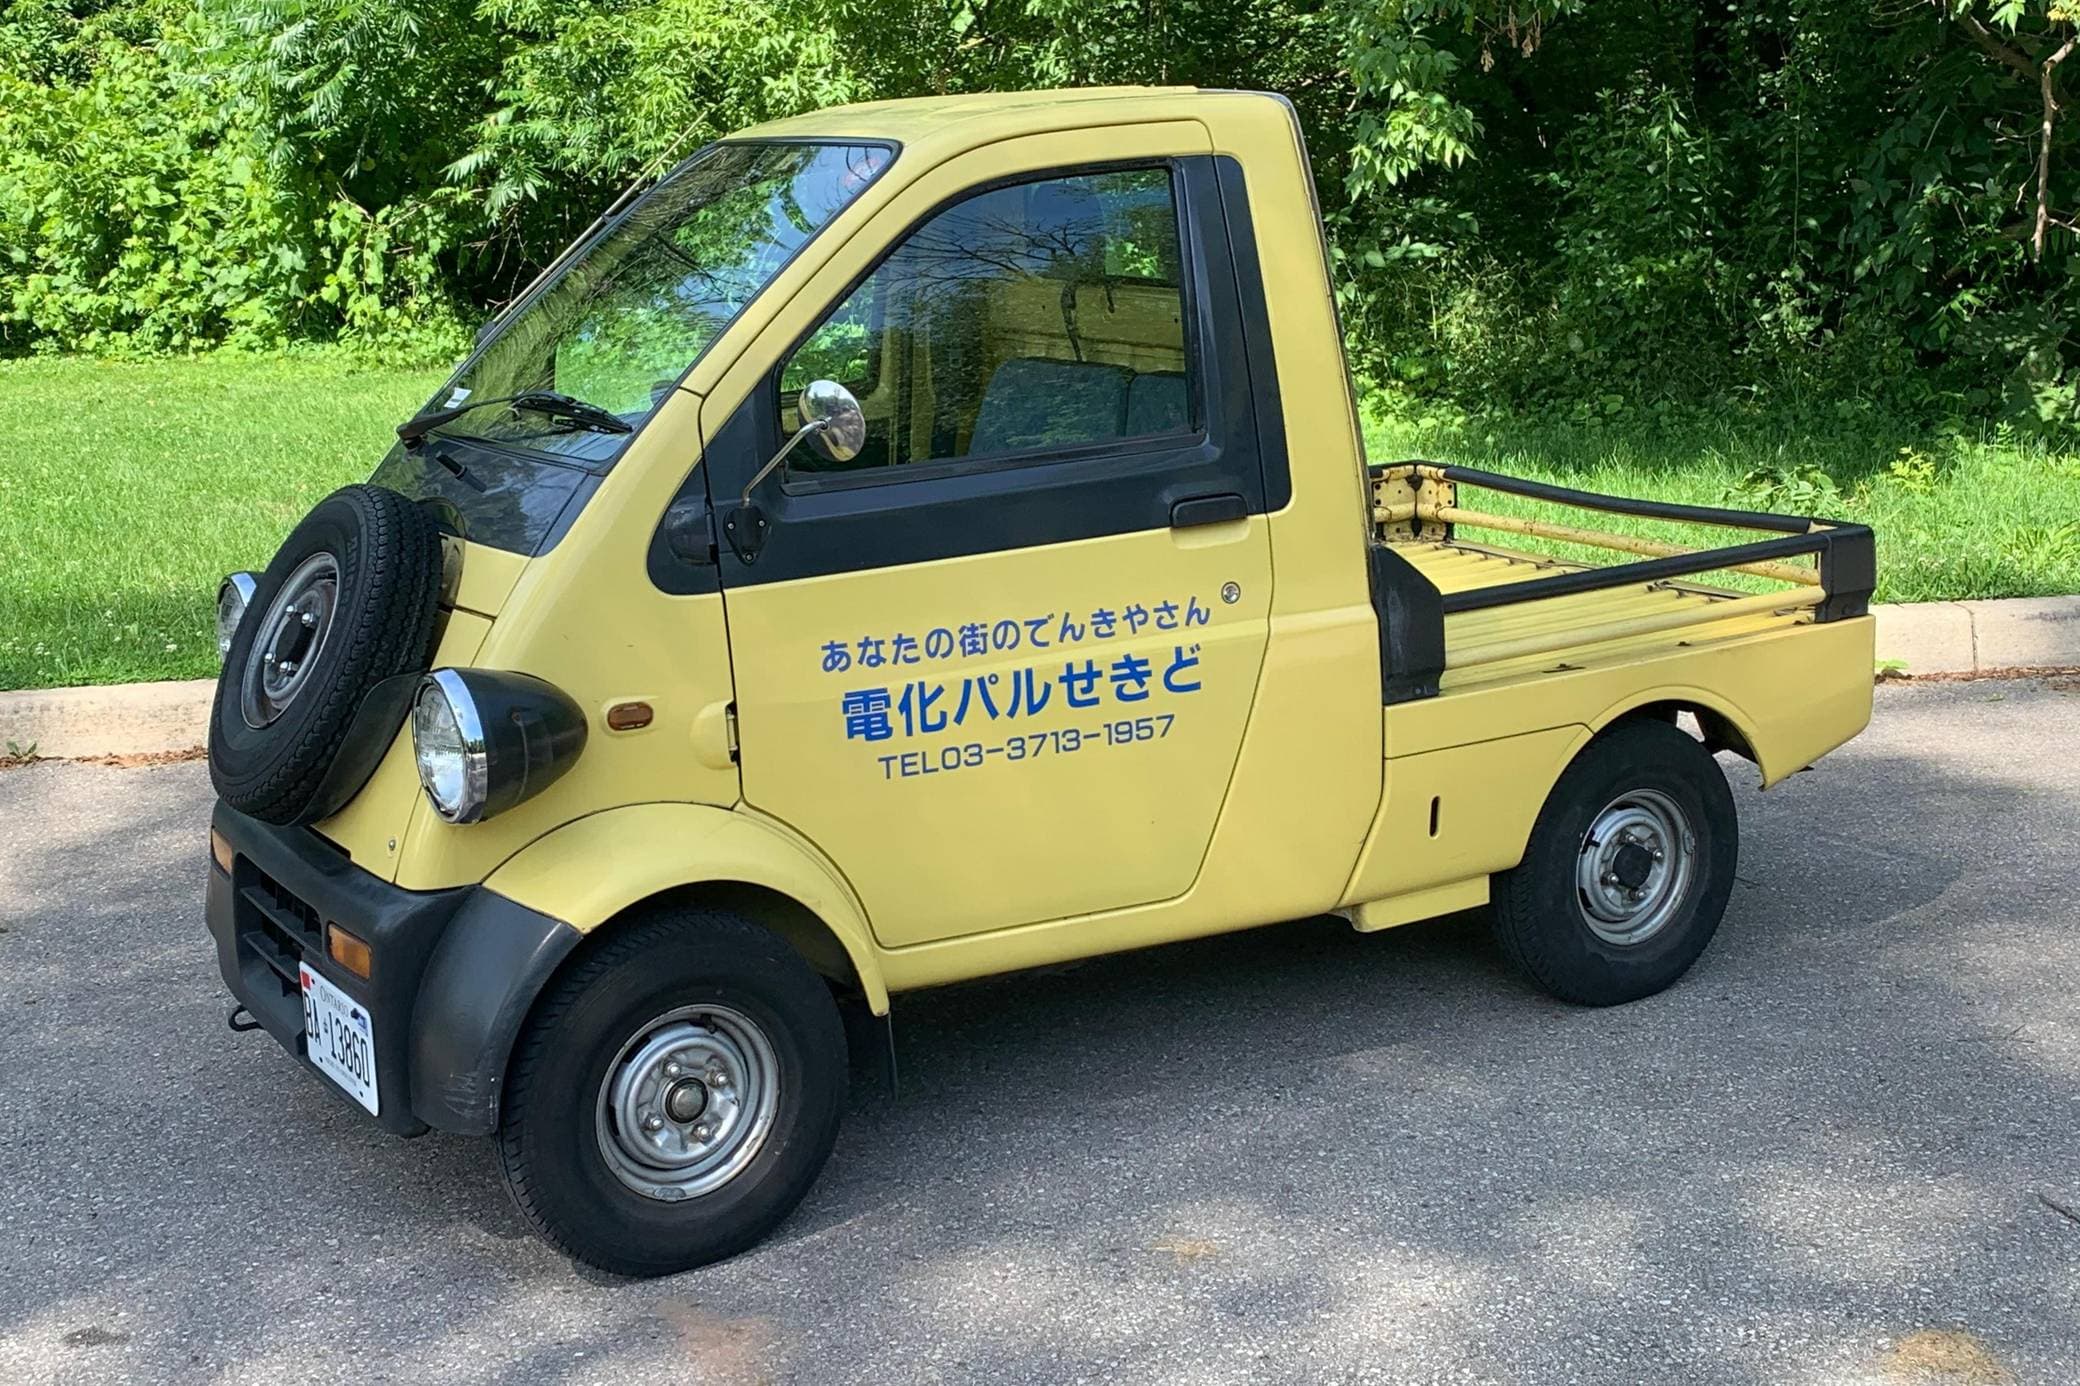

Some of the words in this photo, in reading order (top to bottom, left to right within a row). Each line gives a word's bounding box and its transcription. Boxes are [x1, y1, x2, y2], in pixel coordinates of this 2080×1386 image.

[821, 596, 1210, 673] あなたの街のでんきやさん
[841, 643, 1202, 742] 電化パルせきど
